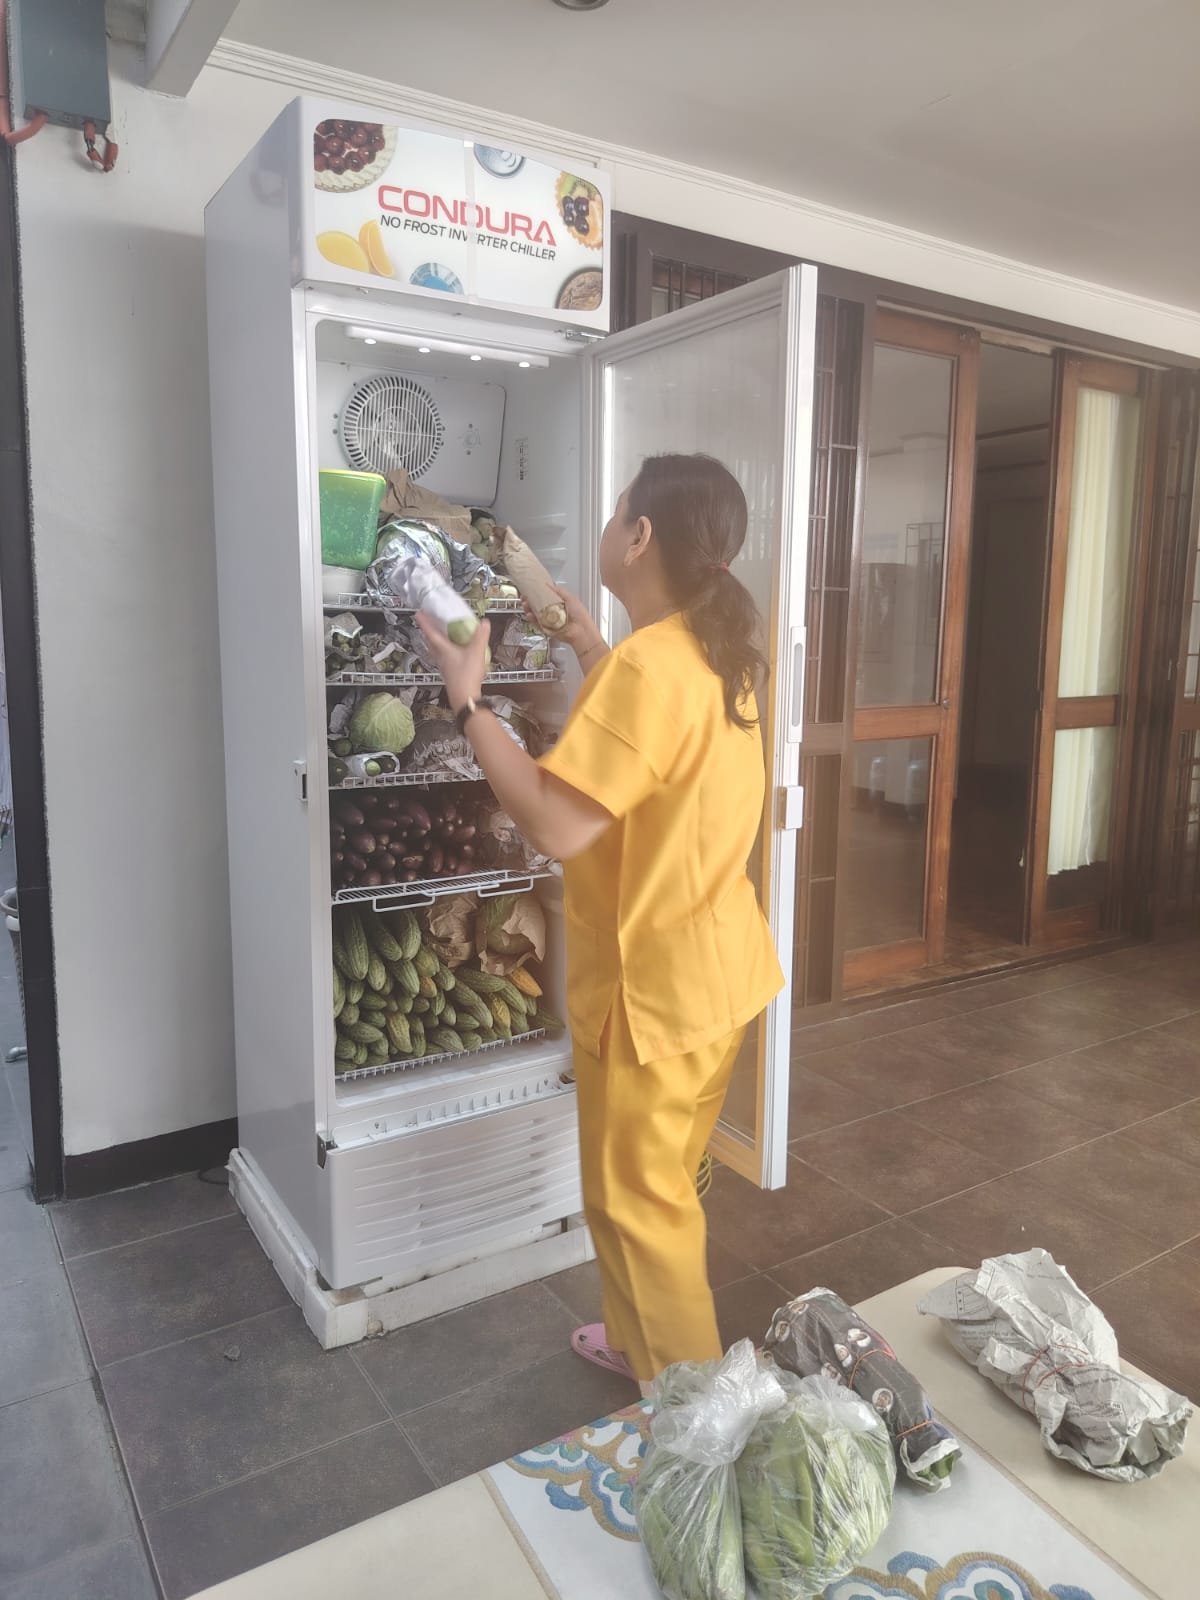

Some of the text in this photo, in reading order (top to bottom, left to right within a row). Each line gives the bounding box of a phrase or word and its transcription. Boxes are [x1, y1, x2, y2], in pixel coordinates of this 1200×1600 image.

[378, 185, 557, 247] CONDURA
[380, 215, 556, 261] NO FROST INVRTER CHILLER
